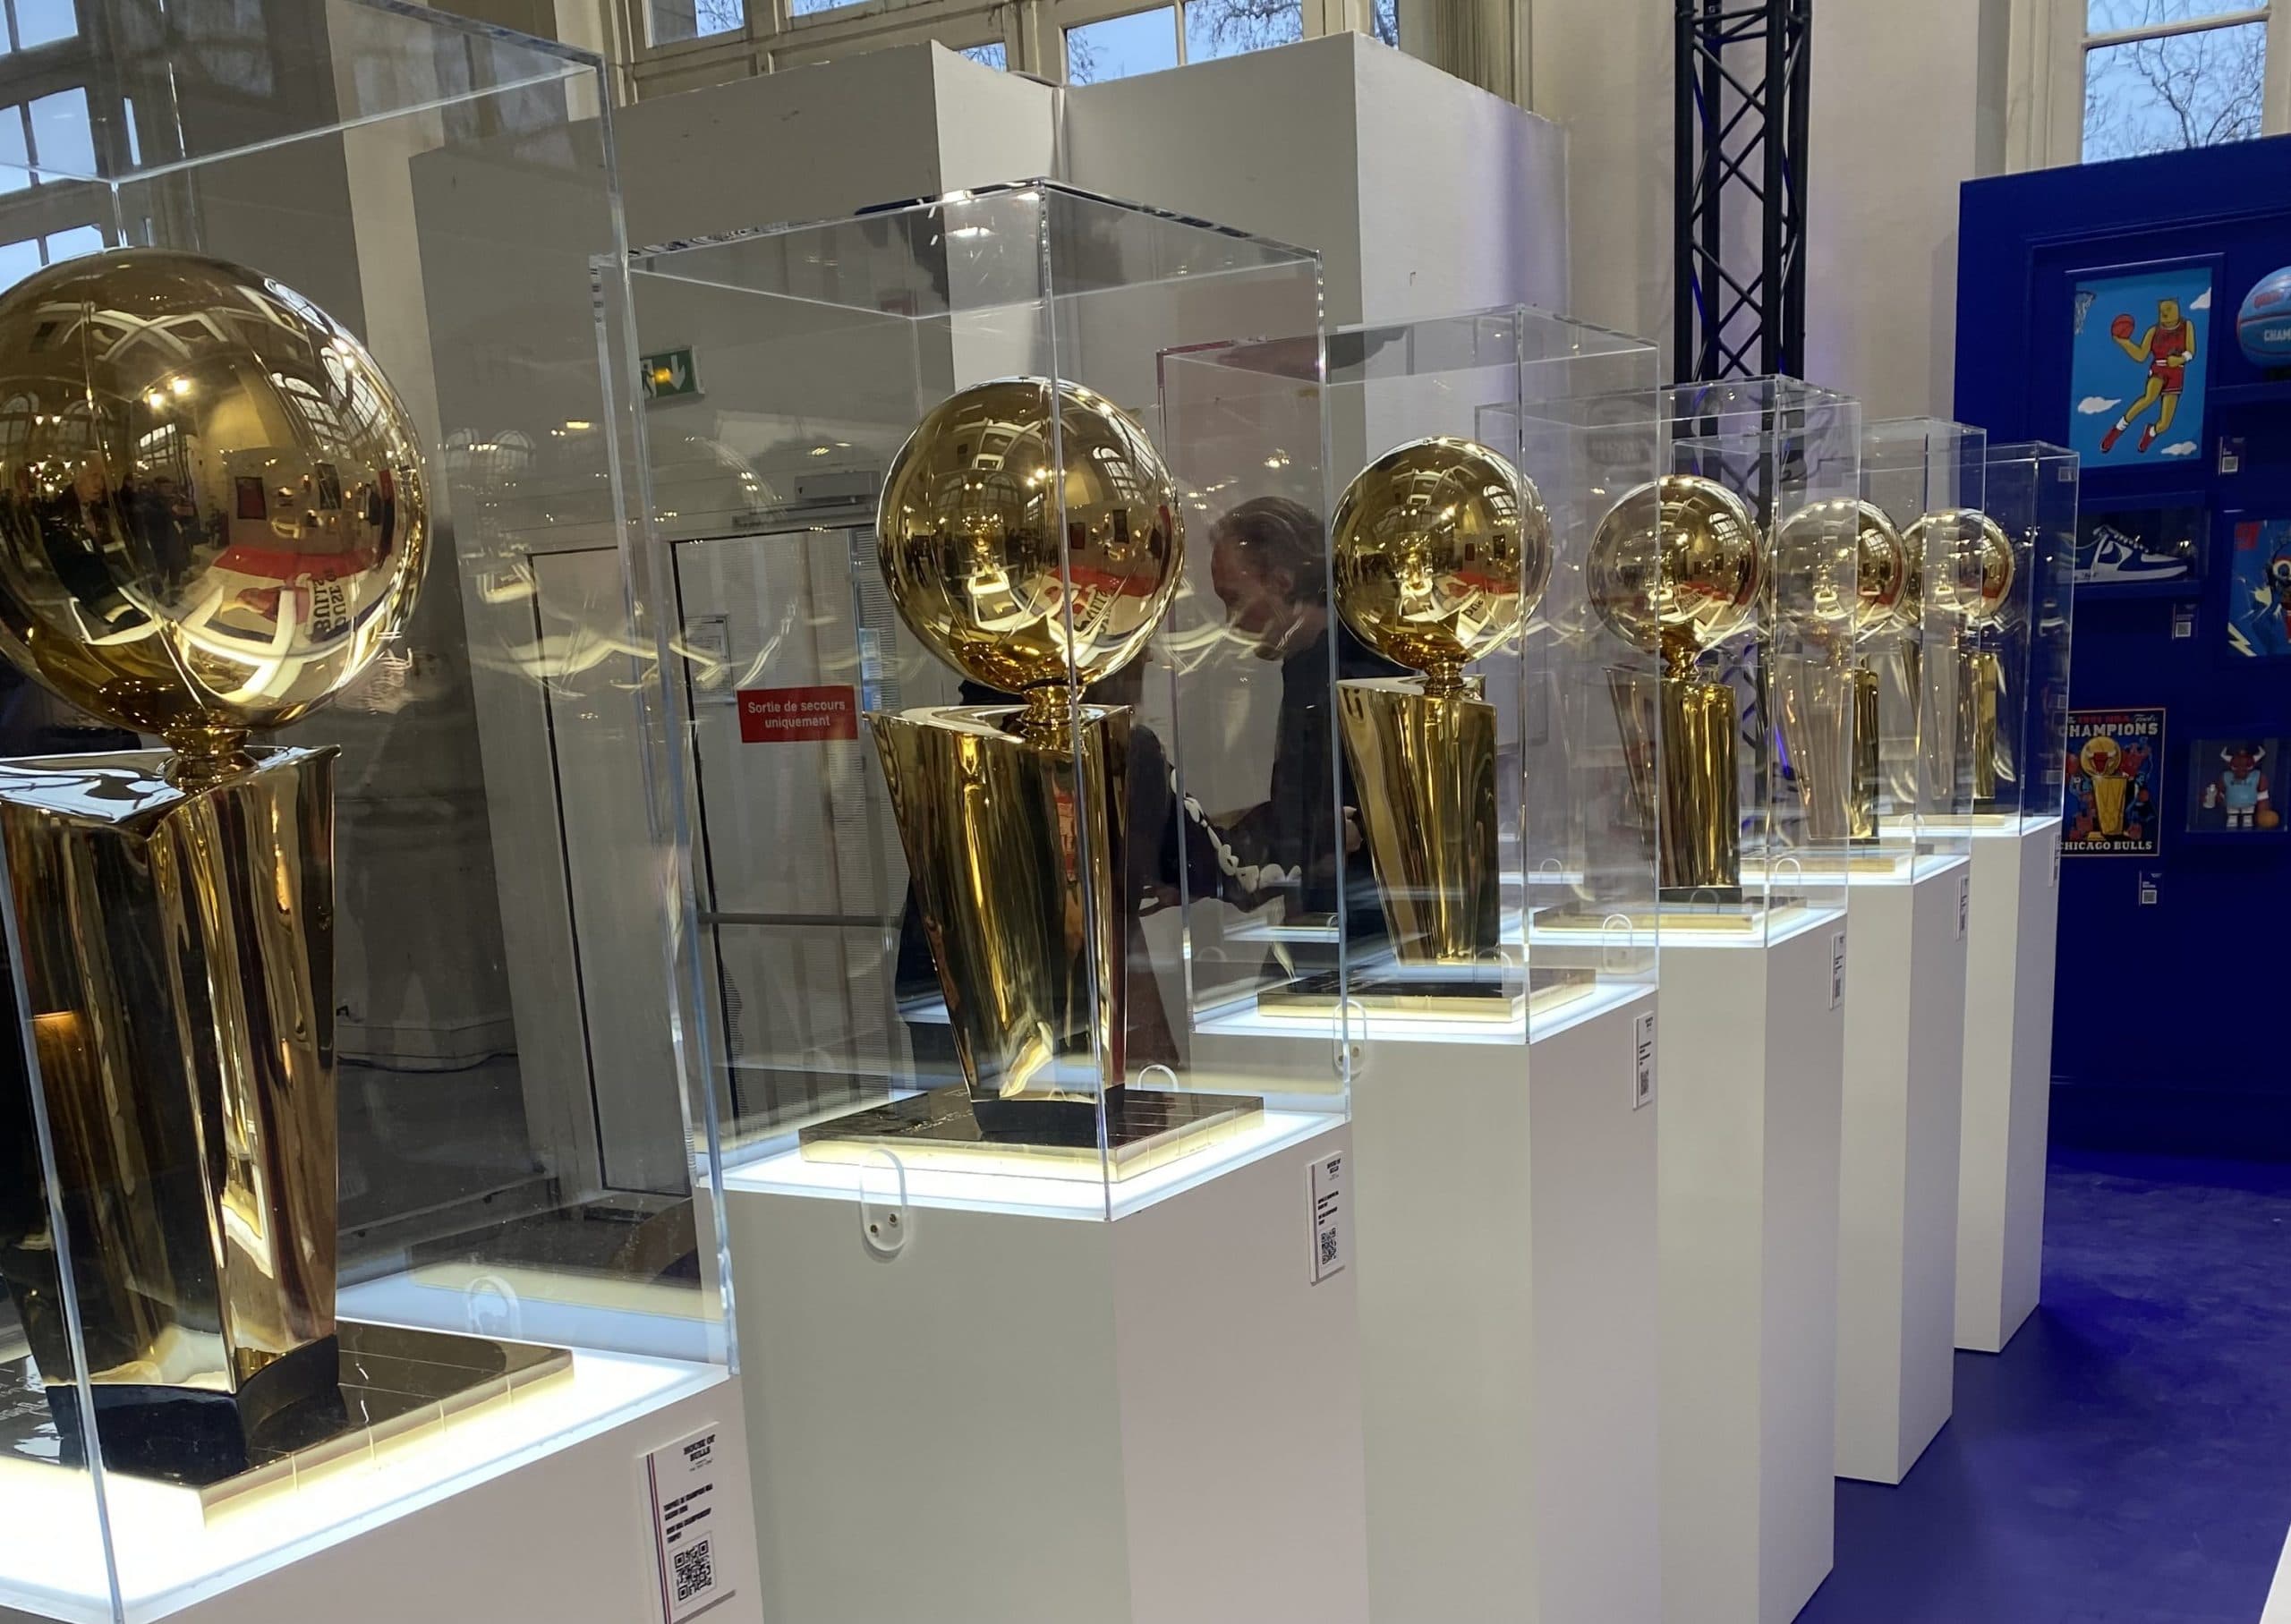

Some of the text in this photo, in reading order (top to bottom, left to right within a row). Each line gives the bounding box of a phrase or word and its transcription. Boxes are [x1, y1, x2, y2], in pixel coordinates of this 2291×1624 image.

[747, 700, 846, 714] Sortie de secours
[764, 716, 830, 729] uniquement
[2113, 840, 2152, 850] BULLS
